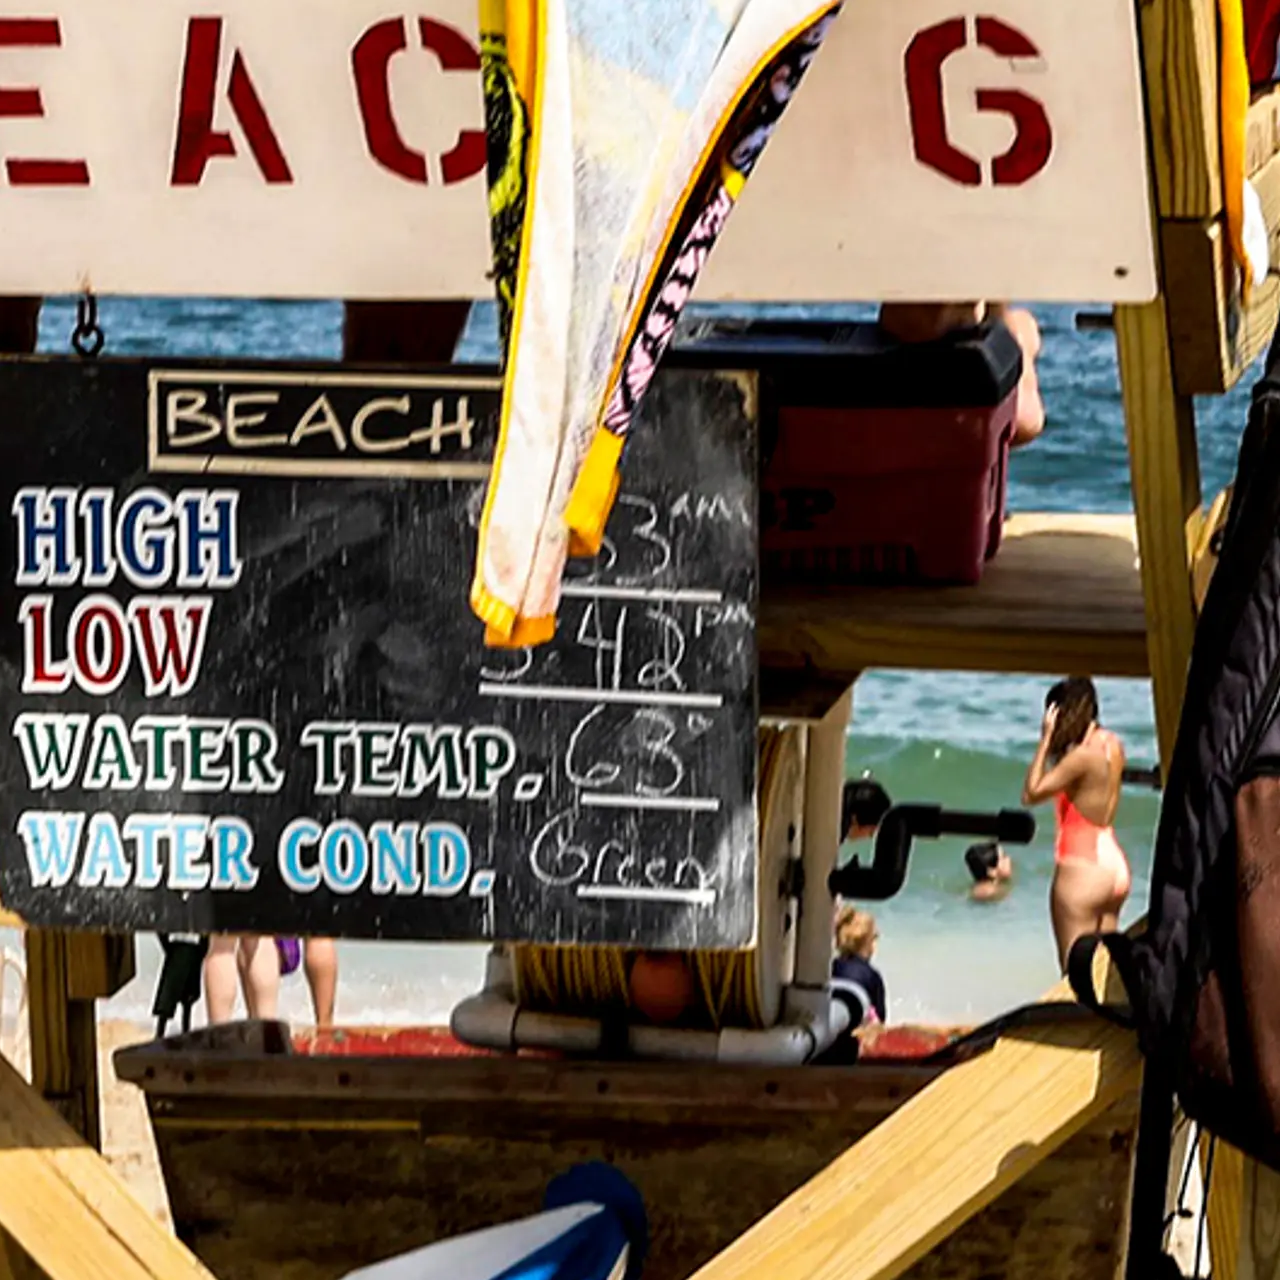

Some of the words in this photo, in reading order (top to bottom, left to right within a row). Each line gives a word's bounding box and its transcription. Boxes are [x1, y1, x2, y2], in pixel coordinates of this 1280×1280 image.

[166, 390, 475, 454] BEACH
[12, 486, 243, 588] HIGH
[18, 593, 213, 697] LOW
[13, 713, 285, 793] WATER
[300, 720, 544, 801] TEMP.
[17, 809, 260, 891] WATER
[277, 817, 496, 898] COND.
